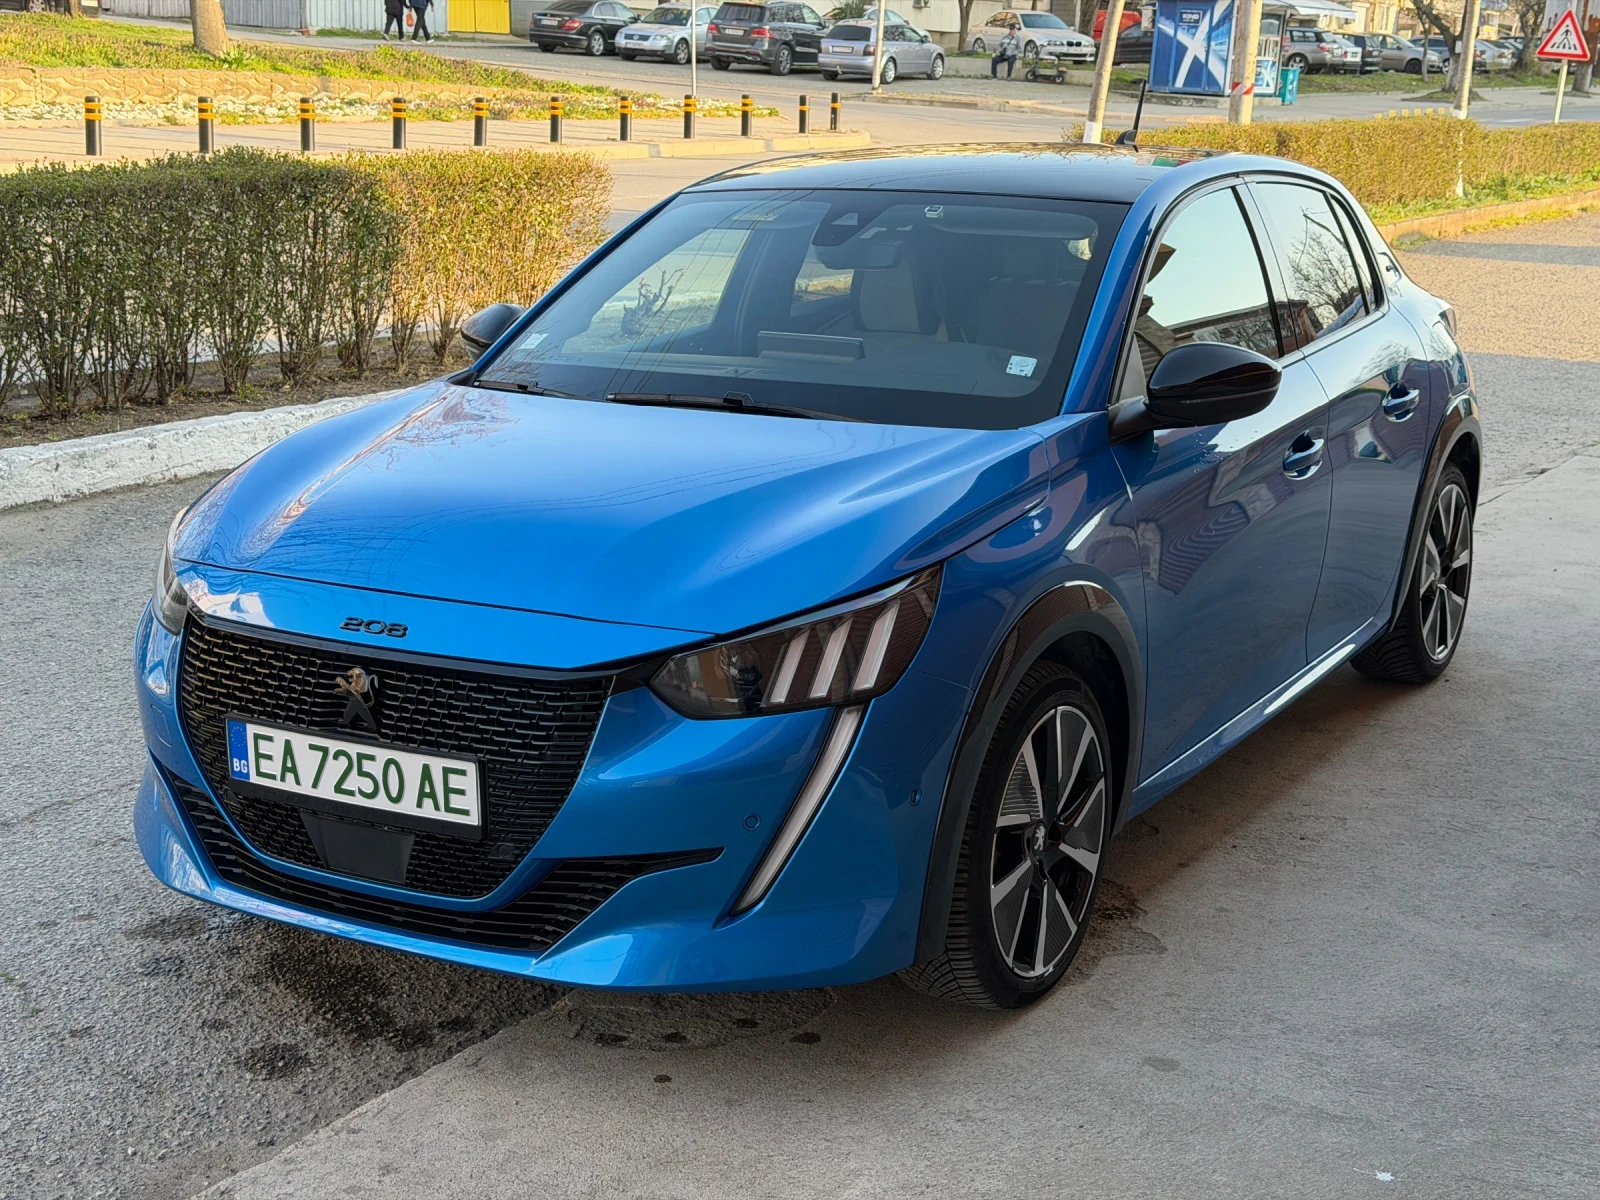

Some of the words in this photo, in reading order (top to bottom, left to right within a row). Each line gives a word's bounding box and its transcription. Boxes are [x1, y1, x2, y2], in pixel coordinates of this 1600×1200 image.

[339, 616, 409, 639] 208
[232, 757, 249, 774] BG
[252, 731, 302, 787] EA
[307, 742, 405, 805] 7250
[415, 762, 471, 817] AE
